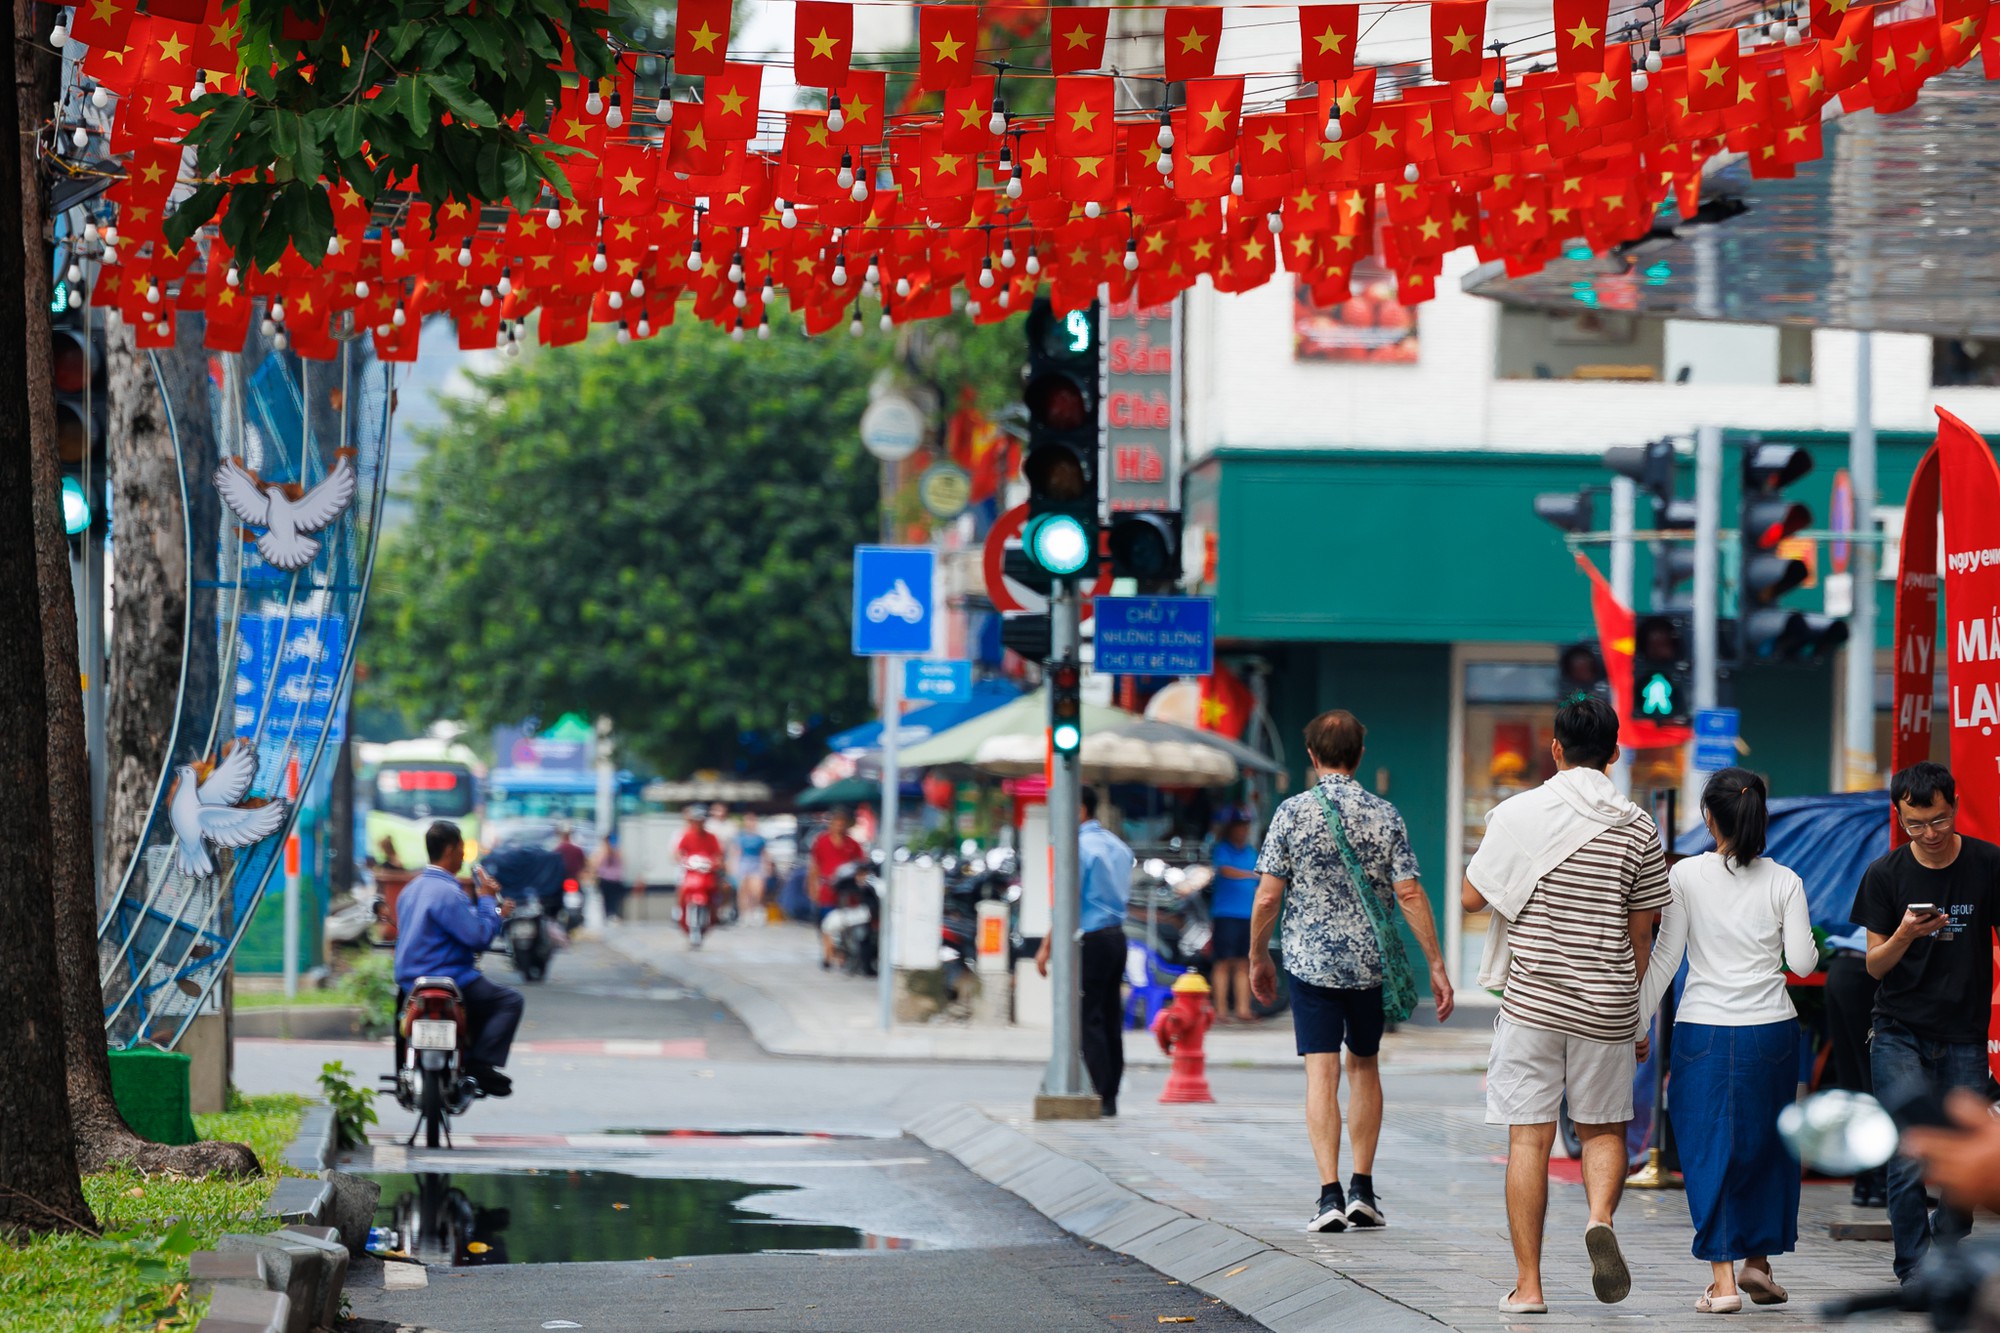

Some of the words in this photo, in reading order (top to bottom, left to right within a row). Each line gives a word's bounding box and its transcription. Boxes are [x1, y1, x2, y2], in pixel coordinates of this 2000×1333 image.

[1067, 309, 1089, 352] 9
[1109, 332, 1171, 374] Sản
[1107, 389, 1170, 429] Chè
[1114, 444, 1164, 482] Hà
[1957, 606, 2000, 663] MÁ
[1954, 682, 2000, 736] LẠ
